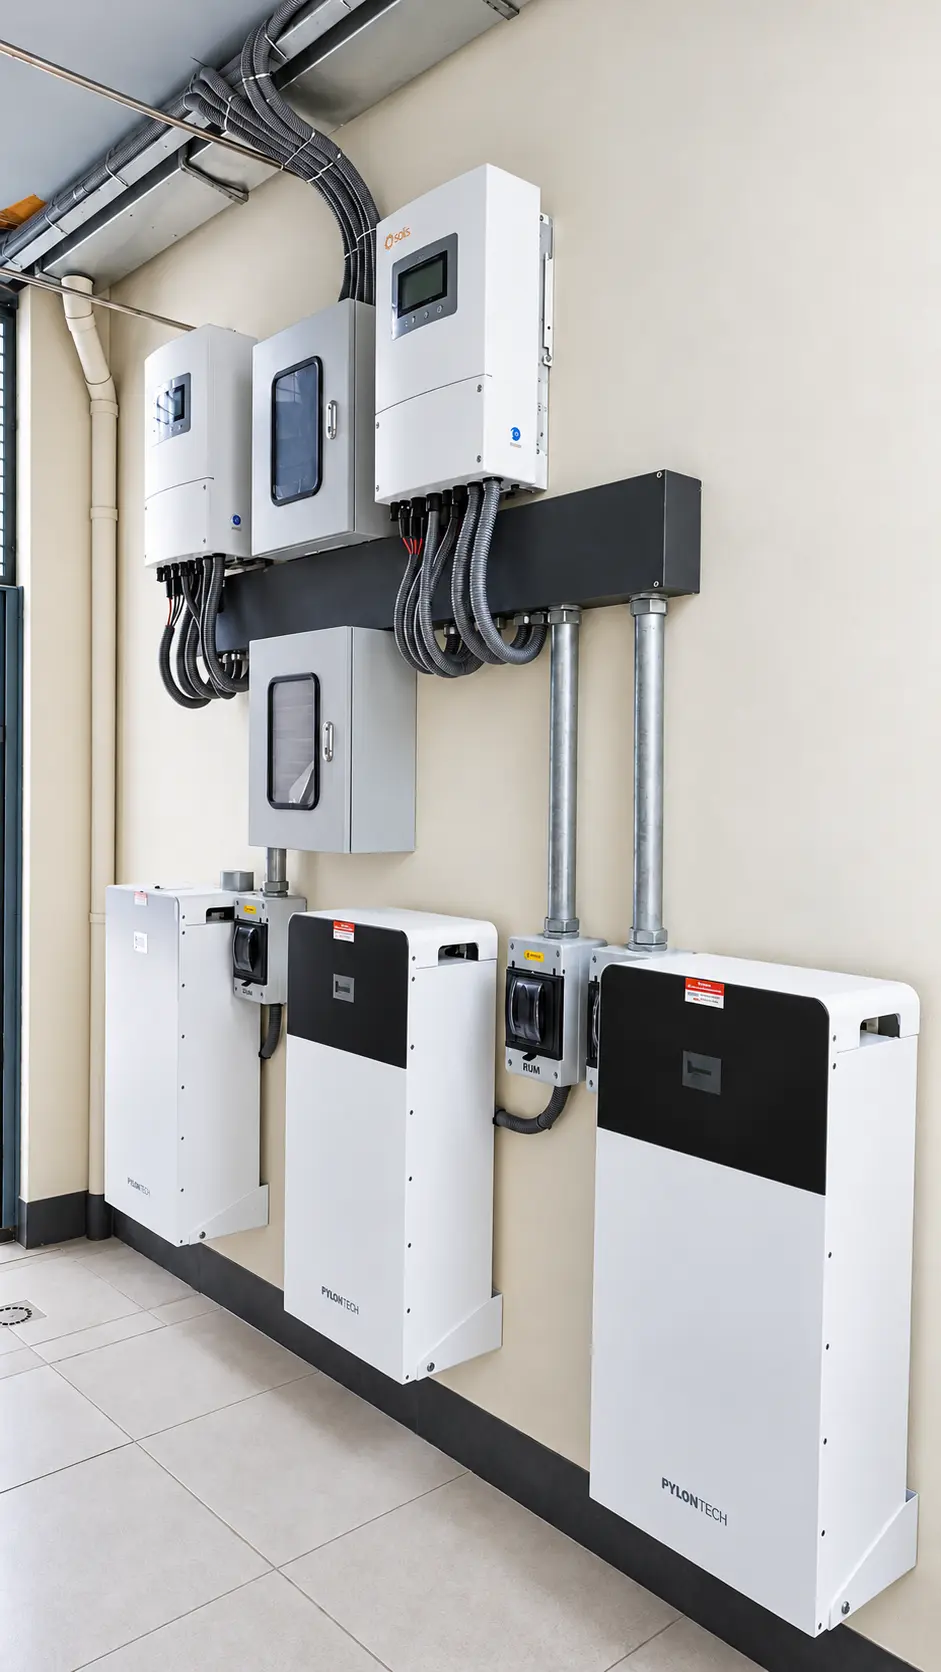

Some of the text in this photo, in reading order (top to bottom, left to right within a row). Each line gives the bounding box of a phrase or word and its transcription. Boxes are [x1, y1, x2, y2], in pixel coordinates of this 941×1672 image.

[522, 1062, 541, 1075] RUM
[321, 1285, 359, 1315] PYLONTECH
[661, 1477, 727, 1526] PYLONTECH
